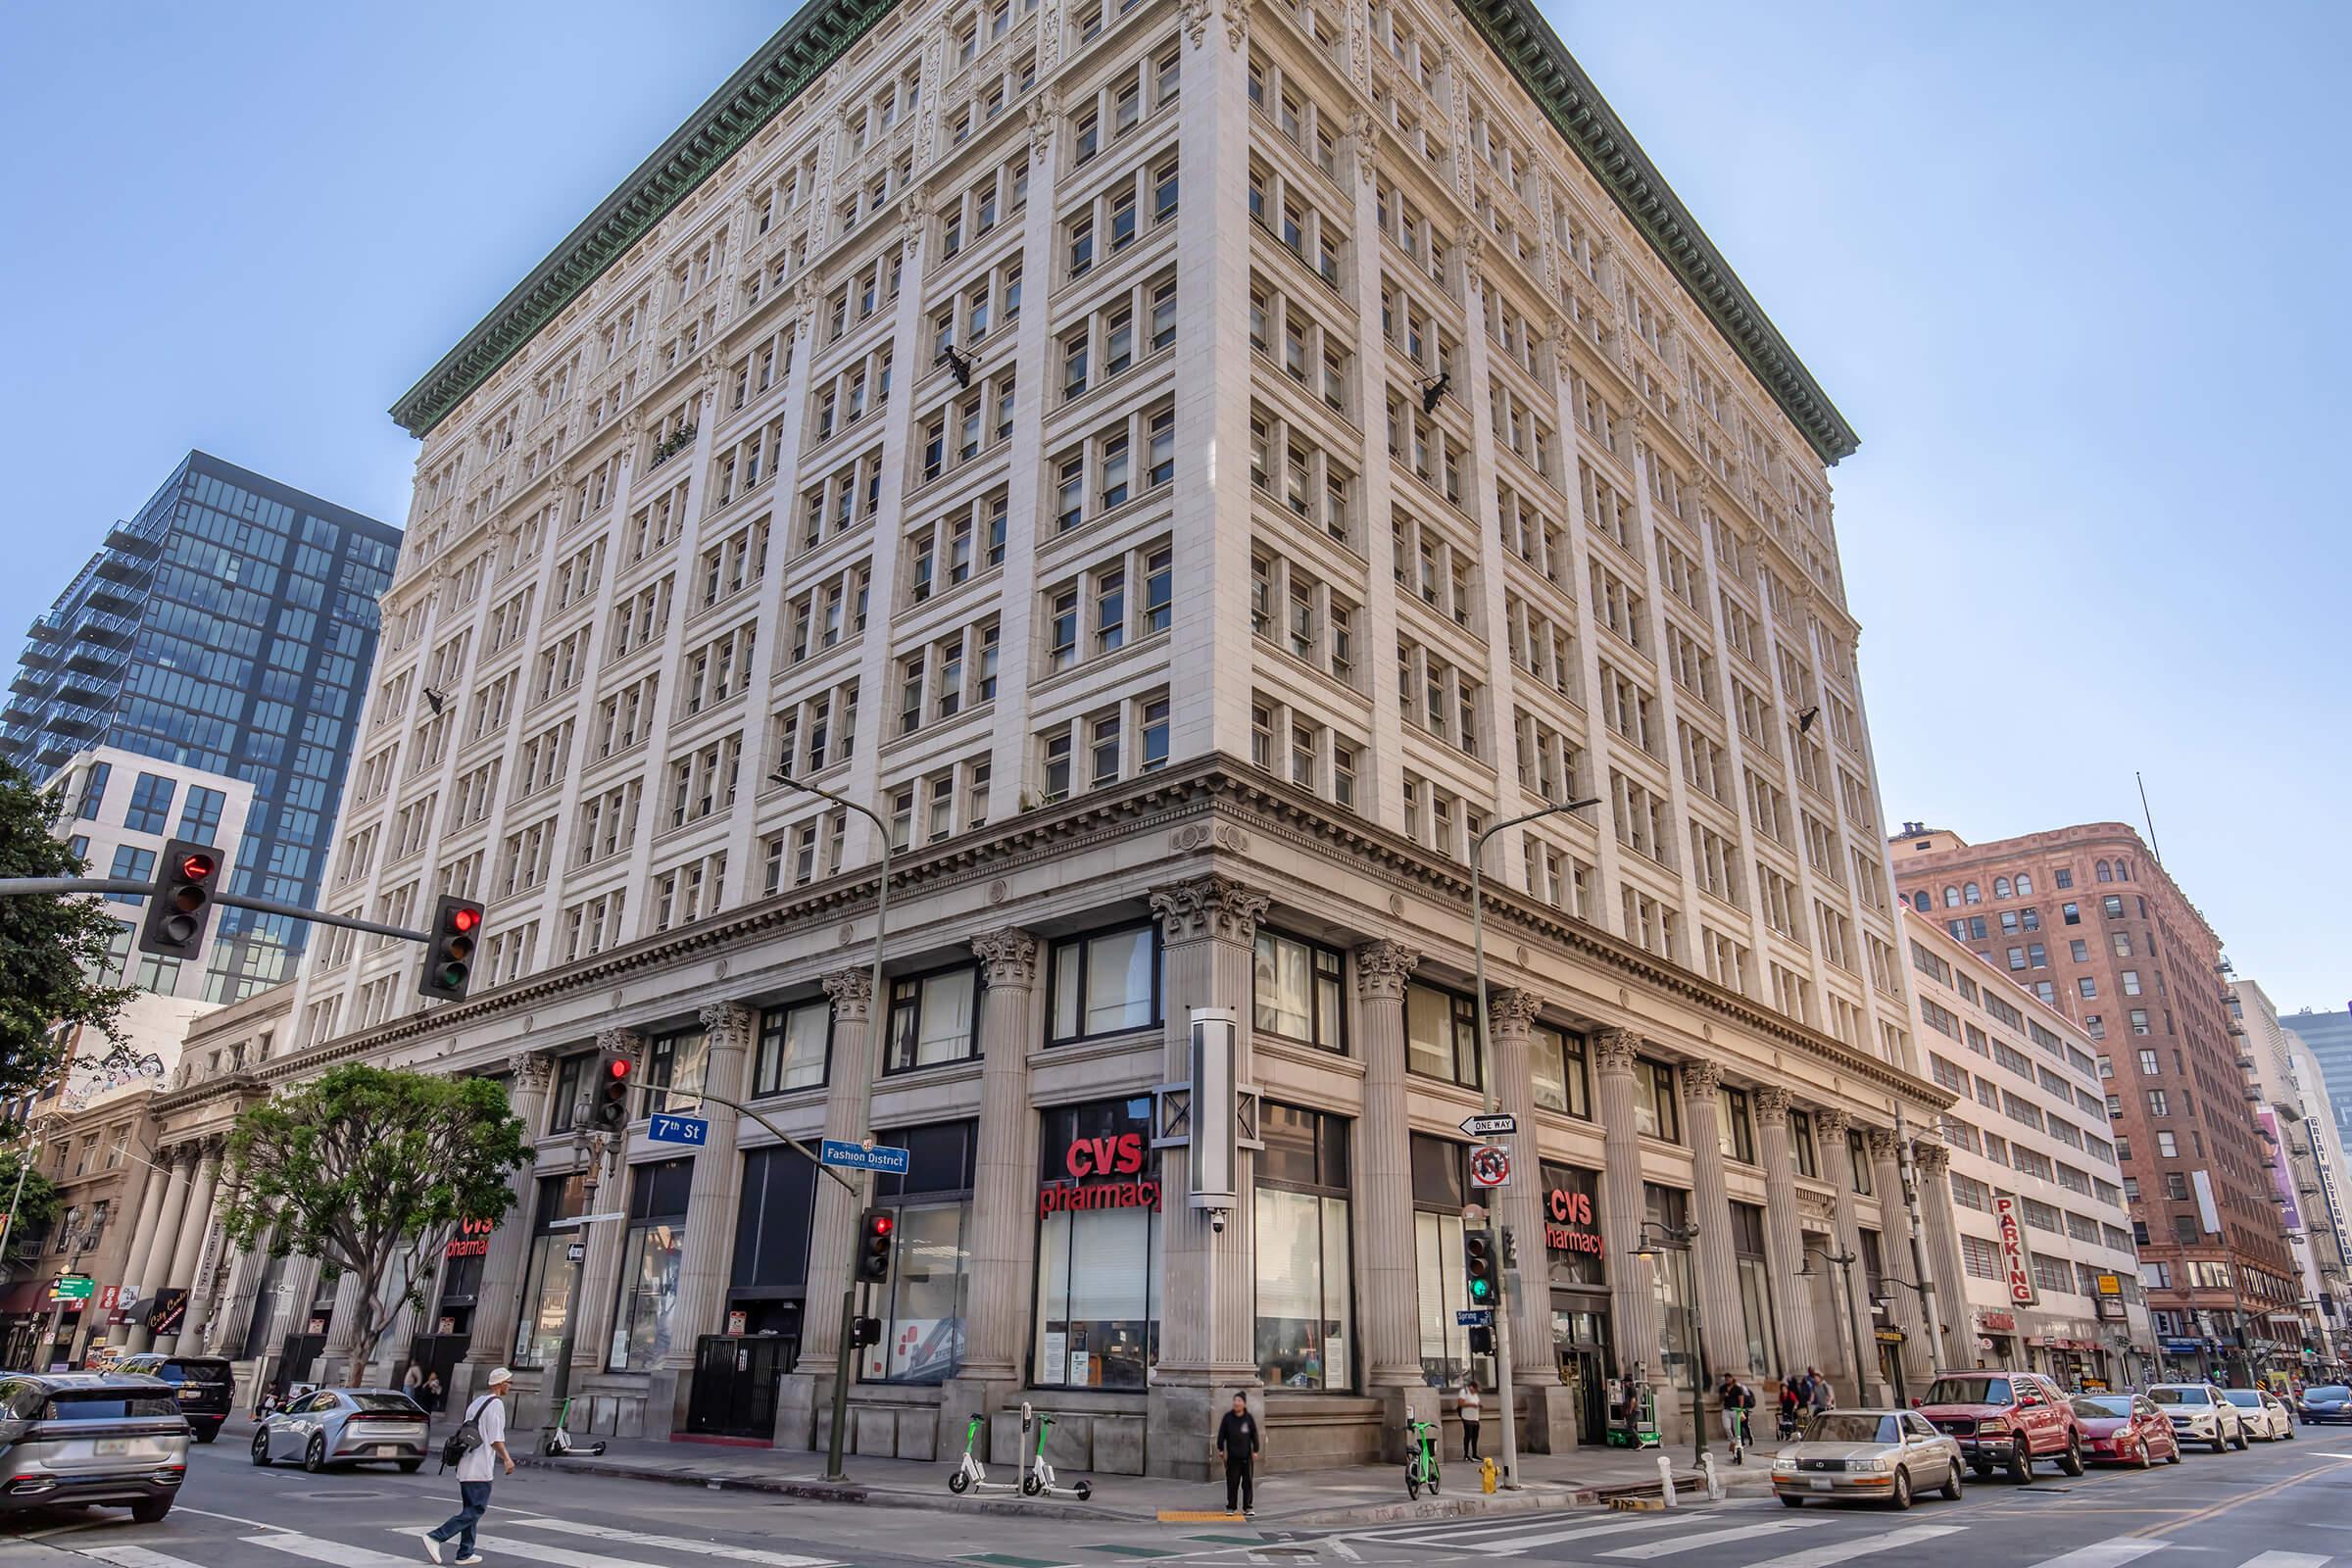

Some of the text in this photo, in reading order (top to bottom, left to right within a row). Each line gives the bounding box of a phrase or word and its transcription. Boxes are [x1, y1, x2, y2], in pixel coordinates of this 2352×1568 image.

[659, 1119, 700, 1139] 7th St
[1475, 1120, 1511, 1131] ONE WAY
[827, 1148, 904, 1166] Fashion District
[1066, 1133, 1143, 1177] CVS
[2310, 1118, 2325, 1161] GREAT
[2322, 1164, 2343, 1225] WESTERN
[1551, 1189, 1592, 1225] CVS
[1545, 1223, 1604, 1260] harmacy
[1997, 1199, 2031, 1299] PARKING
[1458, 1312, 1477, 1322] Spring
